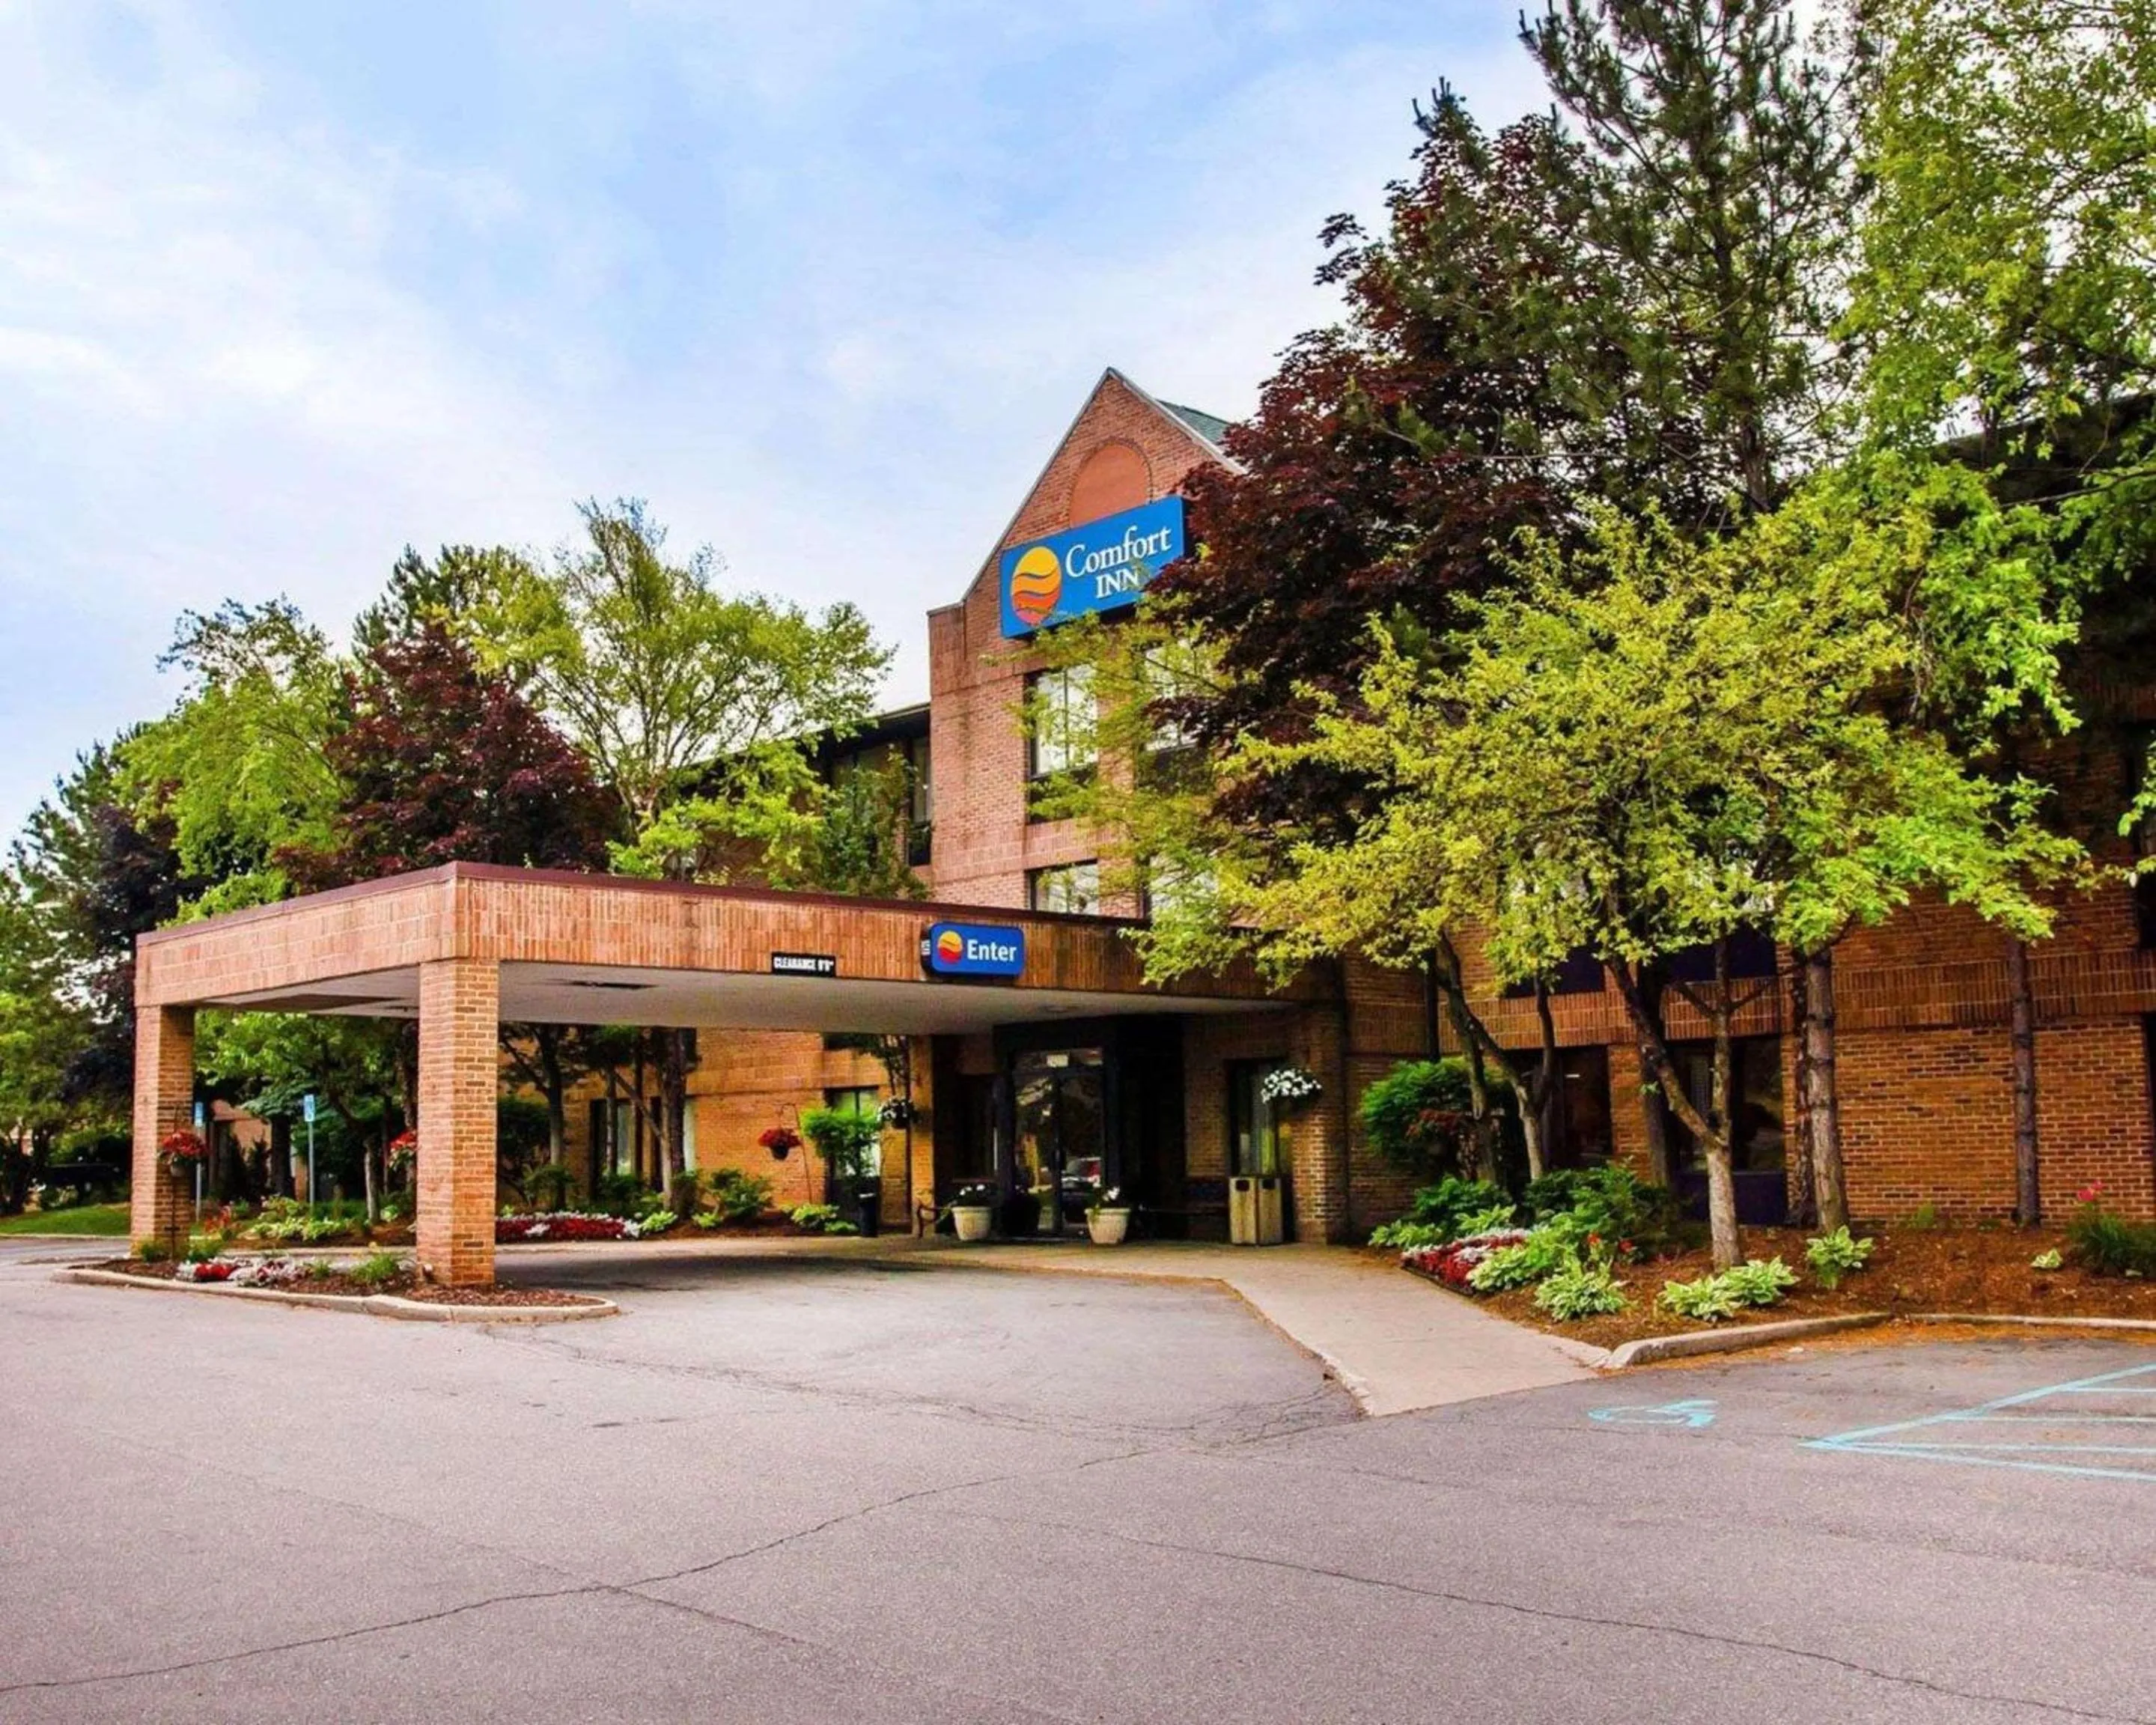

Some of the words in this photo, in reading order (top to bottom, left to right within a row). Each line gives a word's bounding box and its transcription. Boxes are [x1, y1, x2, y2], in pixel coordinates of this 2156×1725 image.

[1065, 526, 1172, 578] Comfort
[1096, 566, 1139, 599] INN
[966, 939, 1017, 961] Enter
